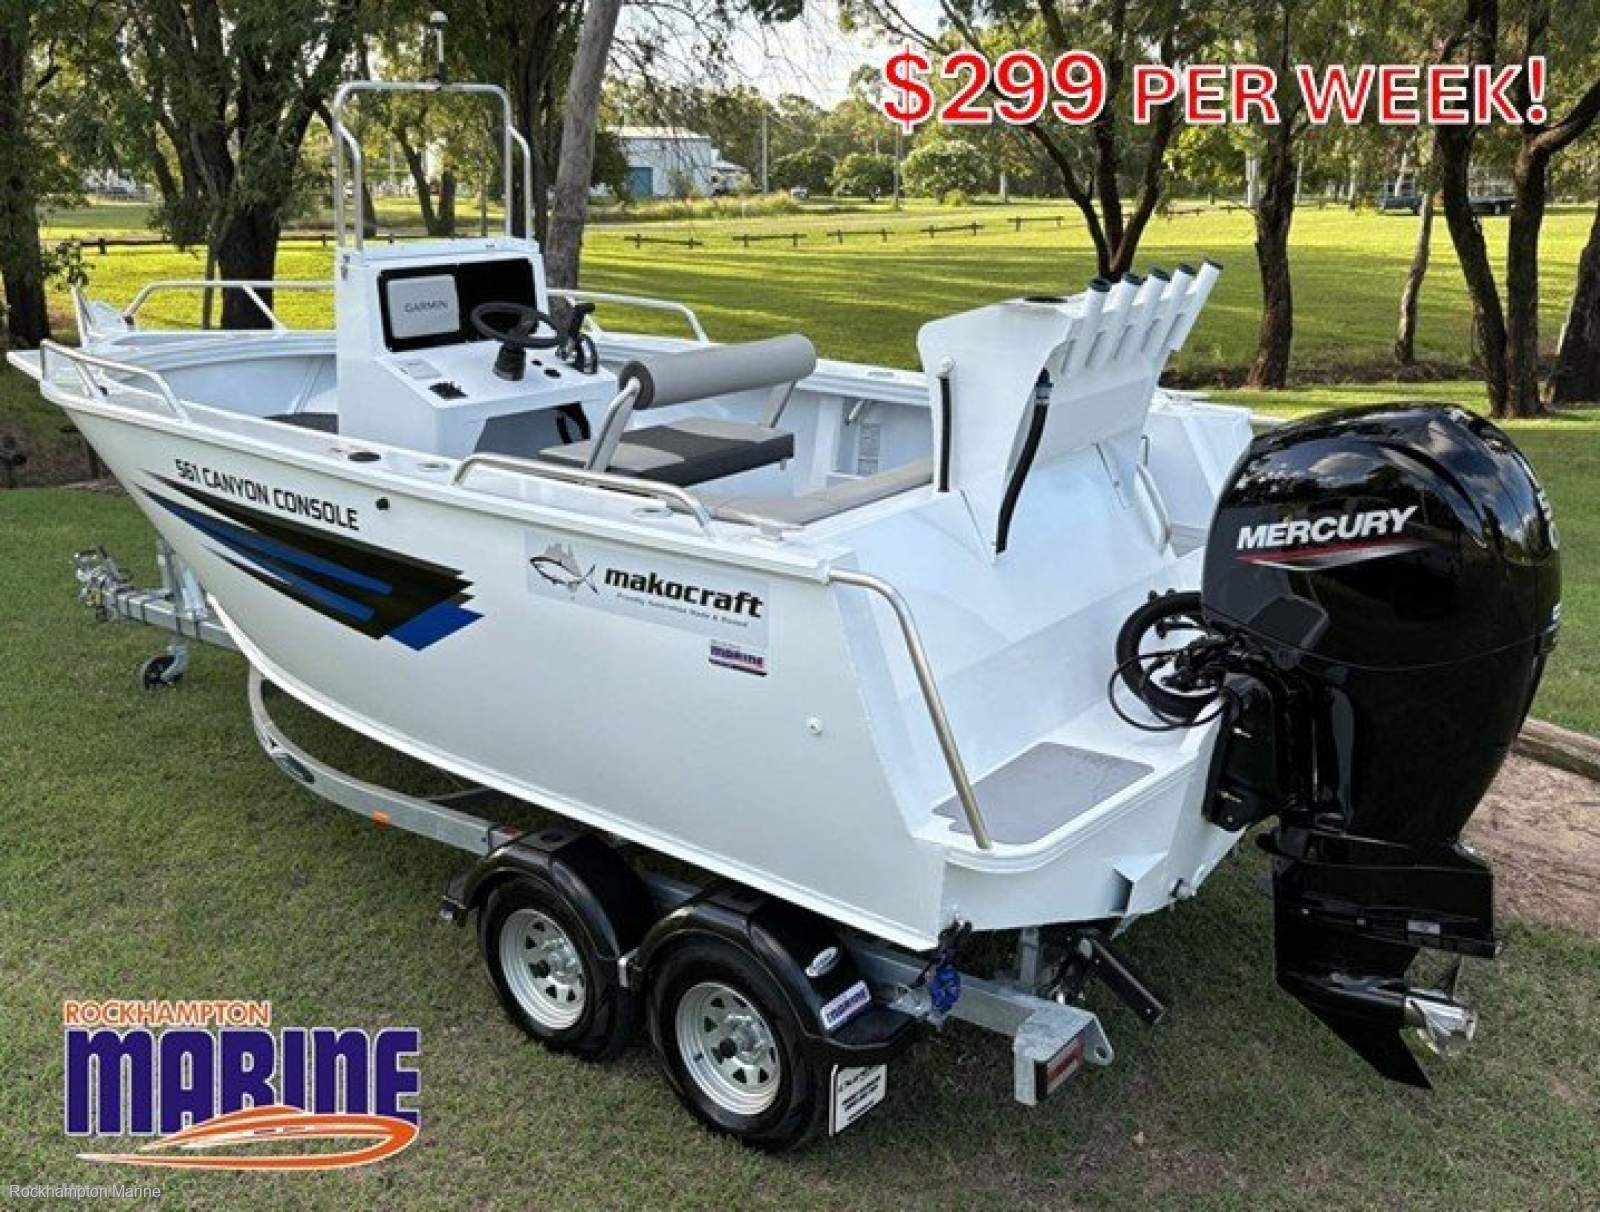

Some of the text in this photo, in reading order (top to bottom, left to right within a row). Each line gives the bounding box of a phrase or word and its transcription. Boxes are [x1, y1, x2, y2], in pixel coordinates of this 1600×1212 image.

[175, 458, 360, 531] 561 CANYON CONSOLE
[1236, 505, 1419, 550] MERCURY
[604, 568, 764, 618] makocraft
